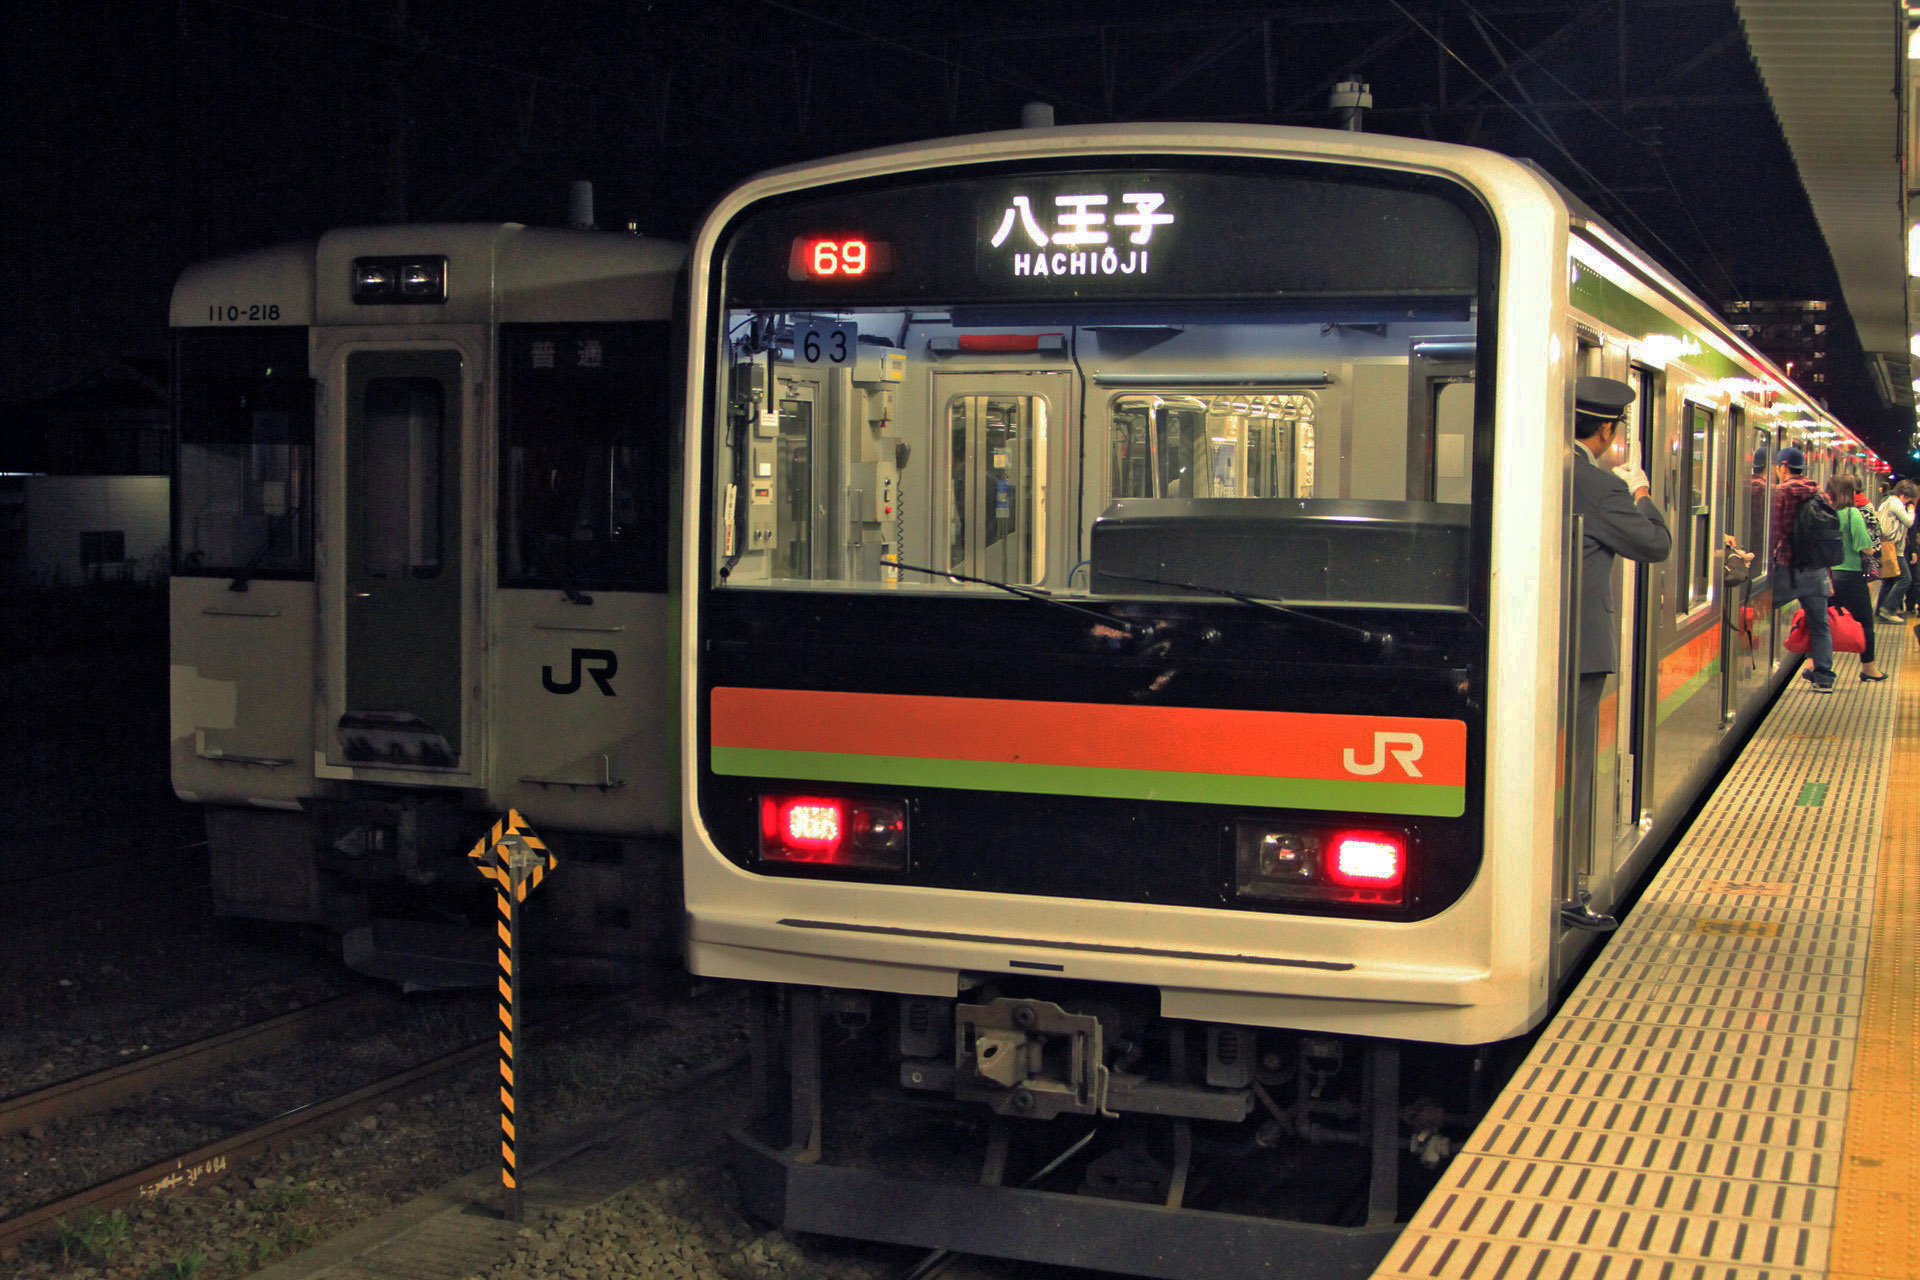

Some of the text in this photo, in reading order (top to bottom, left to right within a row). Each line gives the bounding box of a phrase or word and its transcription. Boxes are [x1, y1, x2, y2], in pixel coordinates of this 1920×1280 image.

[990, 192, 1175, 248] 八王子
[813, 241, 867, 275] 69
[209, 304, 280, 321] 110-218
[803, 330, 848, 364] 63
[542, 648, 618, 697] JR
[1343, 731, 1423, 777] JR
